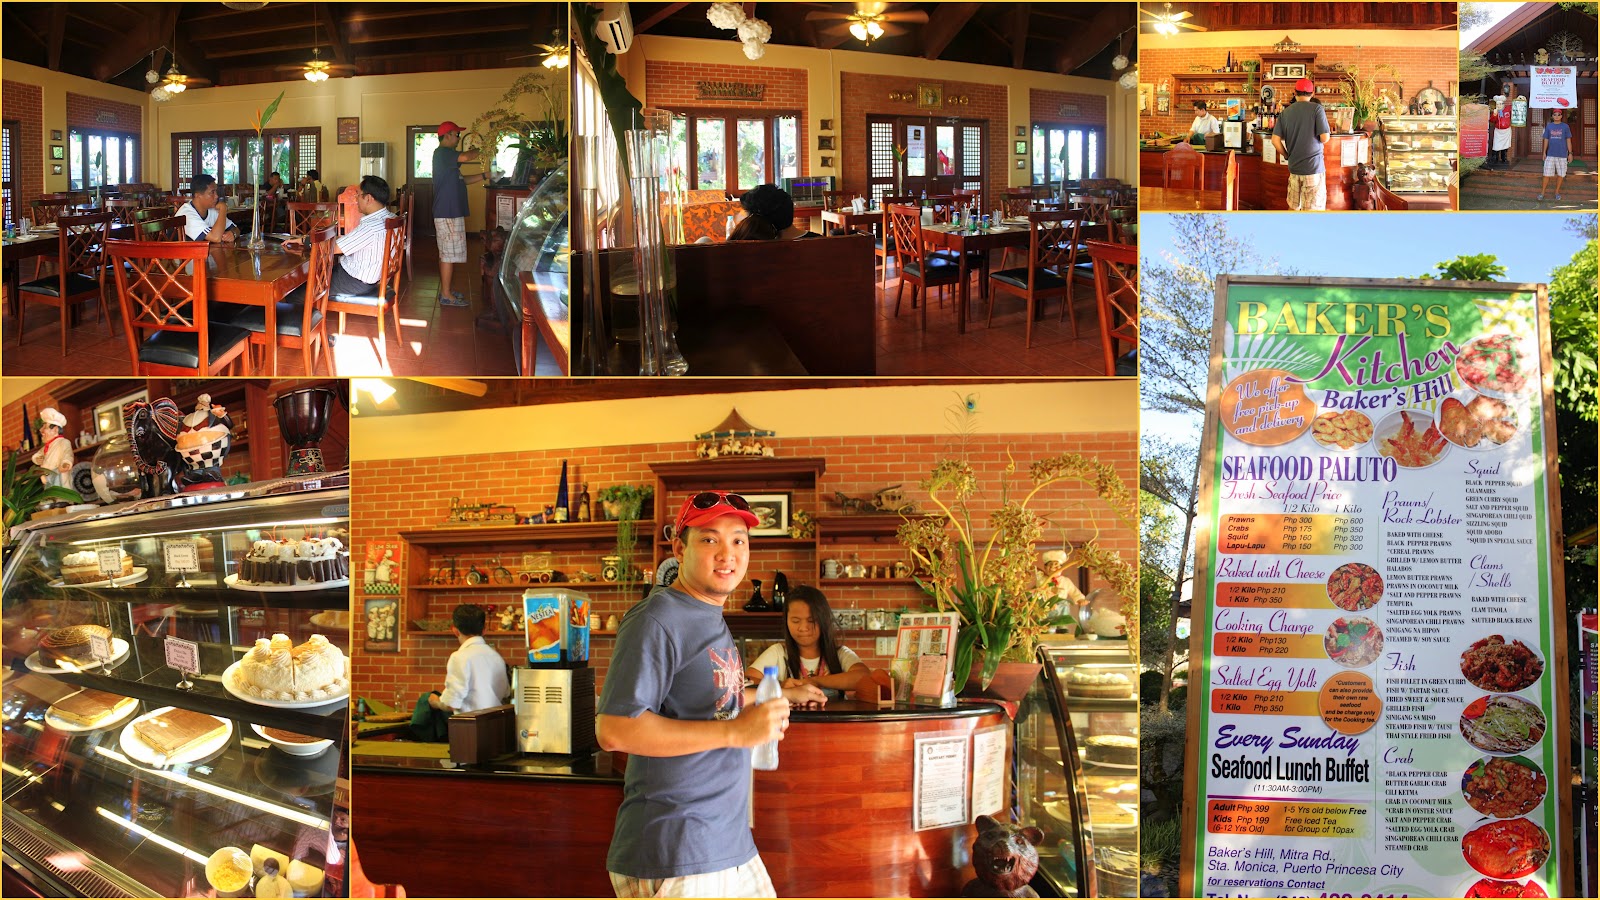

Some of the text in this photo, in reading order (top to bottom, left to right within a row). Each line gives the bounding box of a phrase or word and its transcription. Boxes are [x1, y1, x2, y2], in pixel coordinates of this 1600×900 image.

[1234, 301, 1451, 339] BAKER'S
[1283, 331, 1462, 386] Kitchen
[1236, 376, 1289, 400] We offer
[1321, 372, 1455, 410] Baker's Hill
[1233, 393, 1299, 423] free pick-up
[1235, 410, 1304, 435] and delivery
[1222, 455, 1397, 482] SEAFOOD PALUTO
[1464, 459, 1500, 478] Squid
[1221, 481, 1342, 504] Fresh Seafood Price
[1283, 504, 1320, 513] 1/2 Kilo
[1335, 505, 1362, 513] 1 Kilo
[1383, 507, 1462, 524] Rock Lobster
[1216, 558, 1325, 579] Baked with Cheese
[1470, 554, 1503, 569] Clams
[1257, 587, 1271, 595] Php
[531, 609, 553, 621] NESTEA
[1215, 609, 1314, 637] Cooking Charge
[1260, 637, 1287, 645] Php130
[1384, 653, 1416, 670] Fish
[1212, 665, 1317, 693] Salted Egg Yolk
[1254, 705, 1269, 713] Php
[1215, 724, 1361, 756] Every Sunday
[1384, 746, 1413, 763] Crab
[1212, 753, 1370, 782] Seafood Lunch Buffet
[1254, 784, 1323, 794] (11:30AM-3:00PM)
[1213, 804, 1269, 814] Adult Php 399
[1297, 806, 1310, 814] Yrs
[1325, 807, 1348, 815] below
[1213, 815, 1232, 823] Kids
[1237, 817, 1252, 825] Php
[1248, 825, 1265, 833] Old)
[1294, 826, 1318, 834] Group
[1331, 827, 1354, 835] 10pax
[1208, 847, 1336, 862] Baker's Hill, Mitra Rd.,
[1208, 860, 1404, 878] Sta. Monica, Puerto Princesa City
[1207, 877, 1325, 889] for reservations Contact
